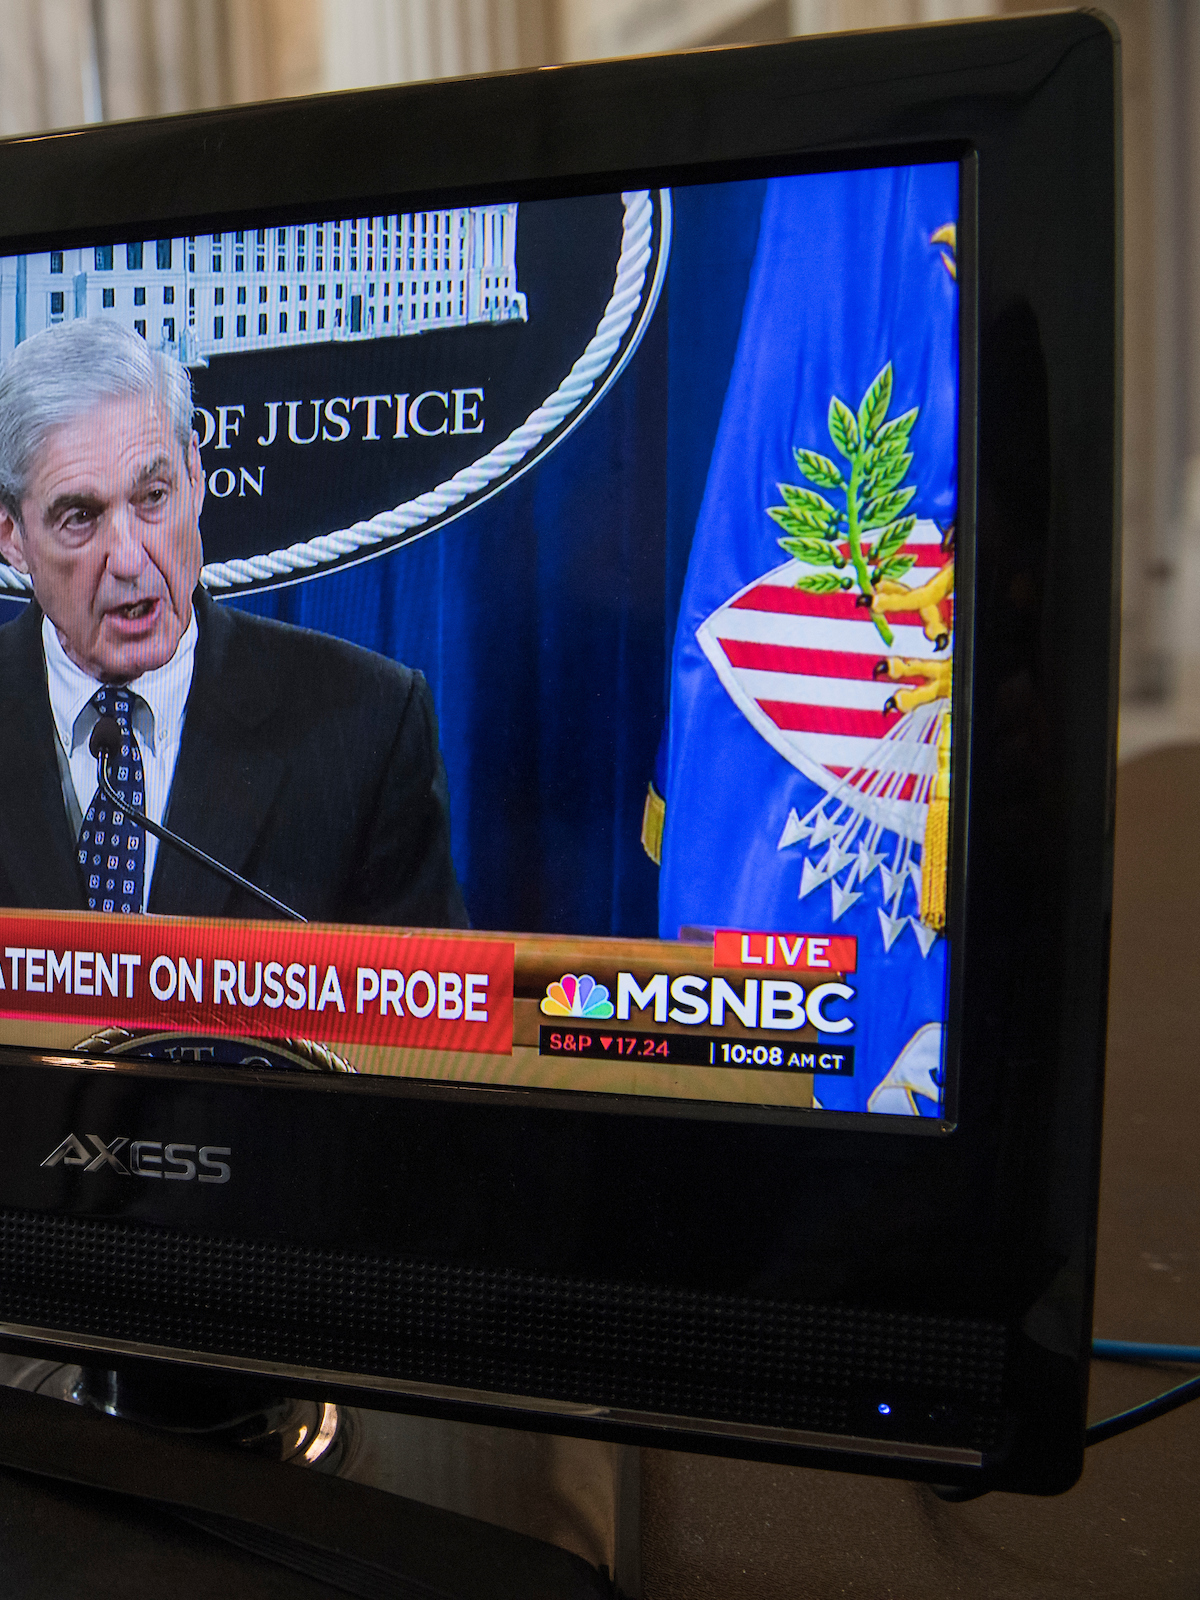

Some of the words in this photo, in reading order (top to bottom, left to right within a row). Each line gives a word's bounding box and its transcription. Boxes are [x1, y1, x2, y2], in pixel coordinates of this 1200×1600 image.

[257, 388, 486, 447] JUSTICE
[740, 934, 831, 968] LIVE
[148, 955, 203, 1002] ON
[213, 960, 347, 1013] RUSSIA
[356, 966, 490, 1022] PROBE
[616, 972, 856, 1034] MSNBC
[550, 1034, 592, 1052] S&P
[616, 1037, 670, 1058] 17.24
[722, 1043, 783, 1067] 10:08
[788, 1052, 815, 1068] AM
[819, 1053, 845, 1070] CT
[40, 1133, 232, 1184] AXESS
